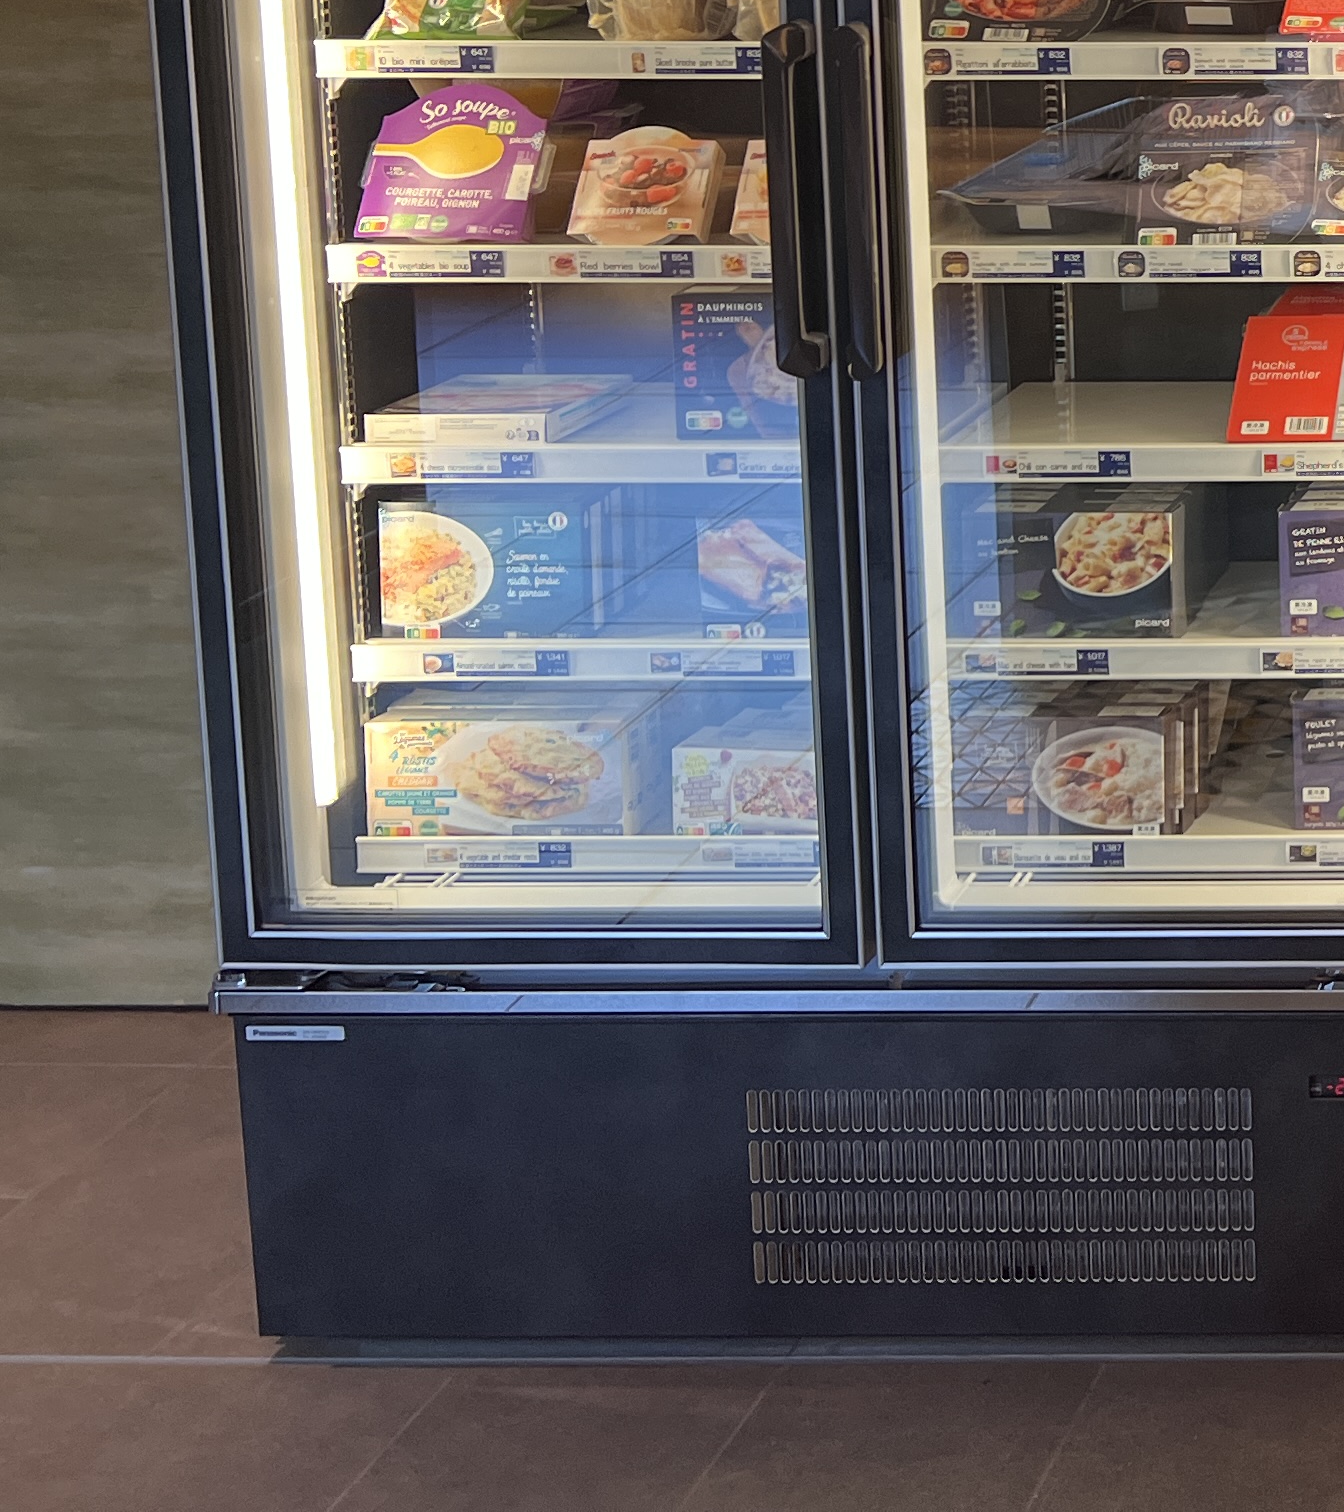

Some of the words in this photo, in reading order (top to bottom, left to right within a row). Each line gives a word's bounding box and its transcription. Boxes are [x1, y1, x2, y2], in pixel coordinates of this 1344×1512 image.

[392, 57, 404, 65] bio
[409, 57, 425, 65] mini
[420, 100, 448, 123] So
[453, 99, 510, 121] soupe
[1168, 102, 1266, 130] Ravioli
[487, 121, 516, 135] BIO
[385, 186, 446, 198] COURGETTE,
[448, 188, 493, 200] CAROTTE,
[394, 197, 440, 209] POIREAU,
[481, 253, 498, 261] 647
[398, 262, 435, 271] vegetables
[580, 262, 598, 271] Red
[603, 262, 634, 271] berries
[639, 262, 659, 271] bowl
[697, 303, 763, 312] DAUPHINOIS
[680, 303, 697, 388] GRATIN
[1252, 360, 1296, 370] Hachis
[1249, 370, 1321, 382] parmentier
[1296, 461, 1343, 470] Shepherd's
[1291, 527, 1326, 537] GRATIN
[1018, 534, 1049, 543] Cheese
[1135, 618, 1170, 629] picard
[1305, 719, 1336, 729] POULET
